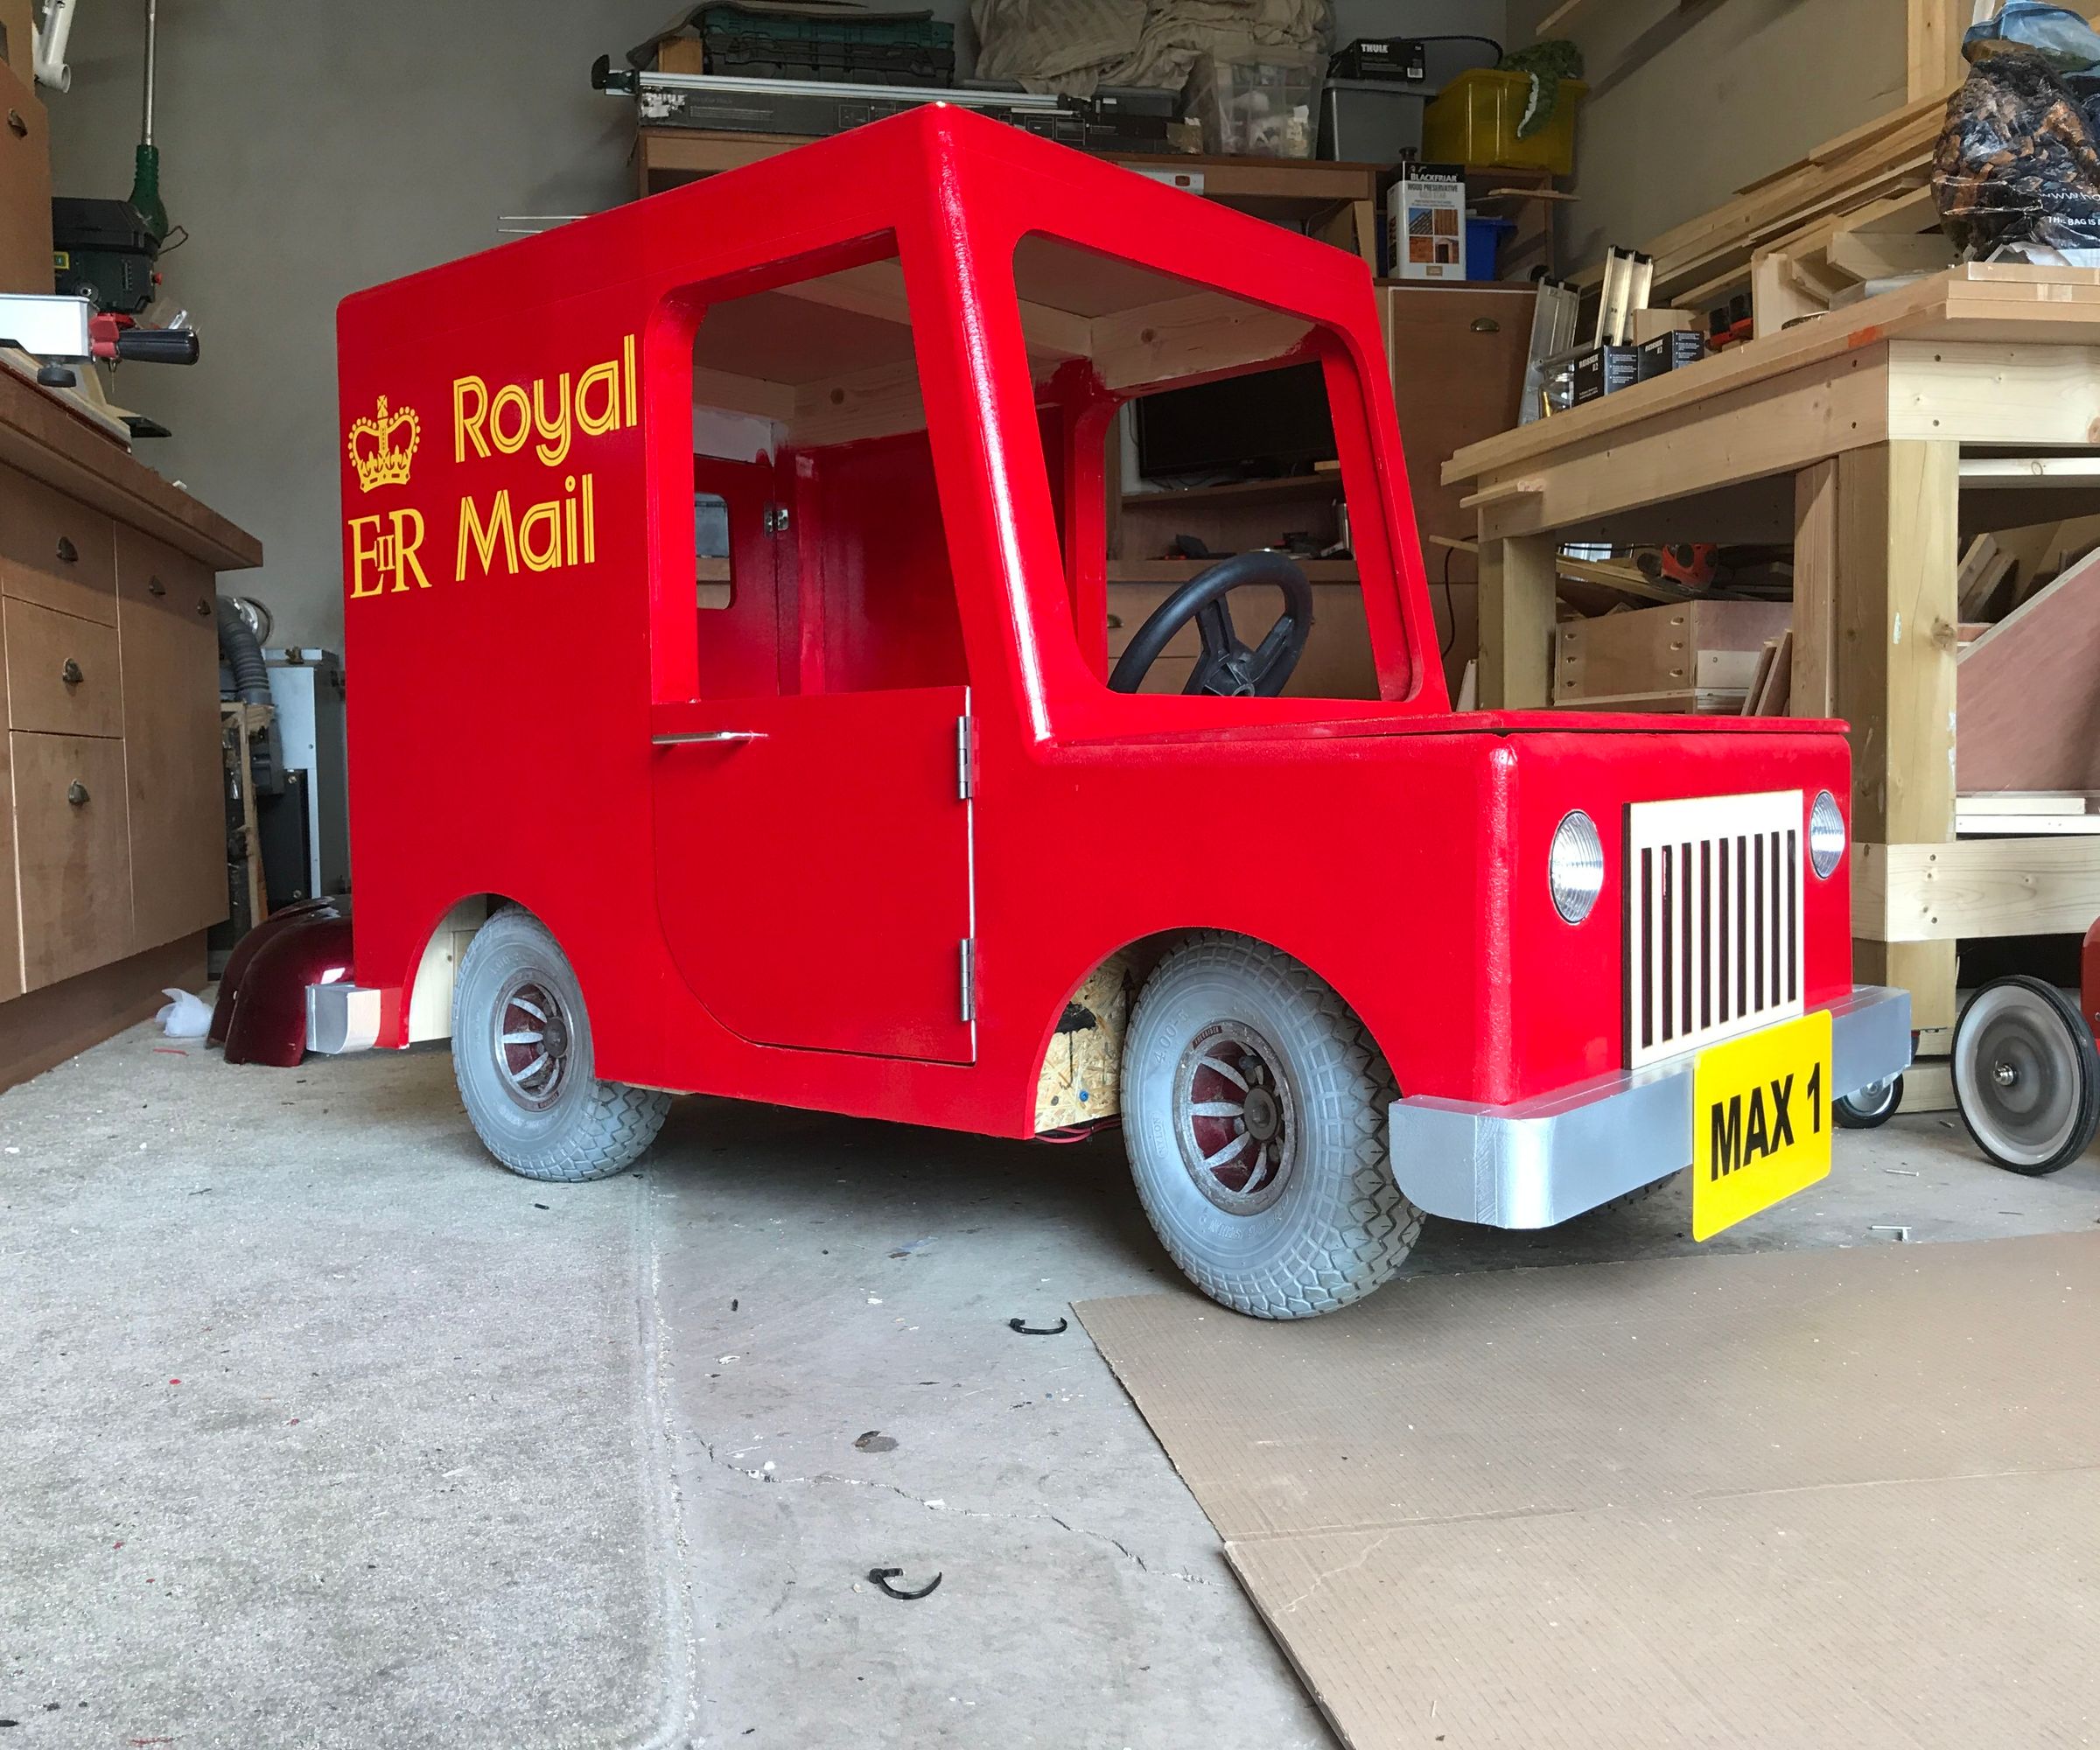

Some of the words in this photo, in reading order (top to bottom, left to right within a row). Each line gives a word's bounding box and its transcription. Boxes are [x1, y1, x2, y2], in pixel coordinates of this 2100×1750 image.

[1361, 43, 1389, 53] THULE
[1410, 172, 1458, 183] BLACKFRIAR
[453, 334, 638, 466] Royal
[455, 473, 595, 582] Mail
[1711, 1073, 1795, 1181] MAX
[1806, 1061, 1821, 1134] 1
